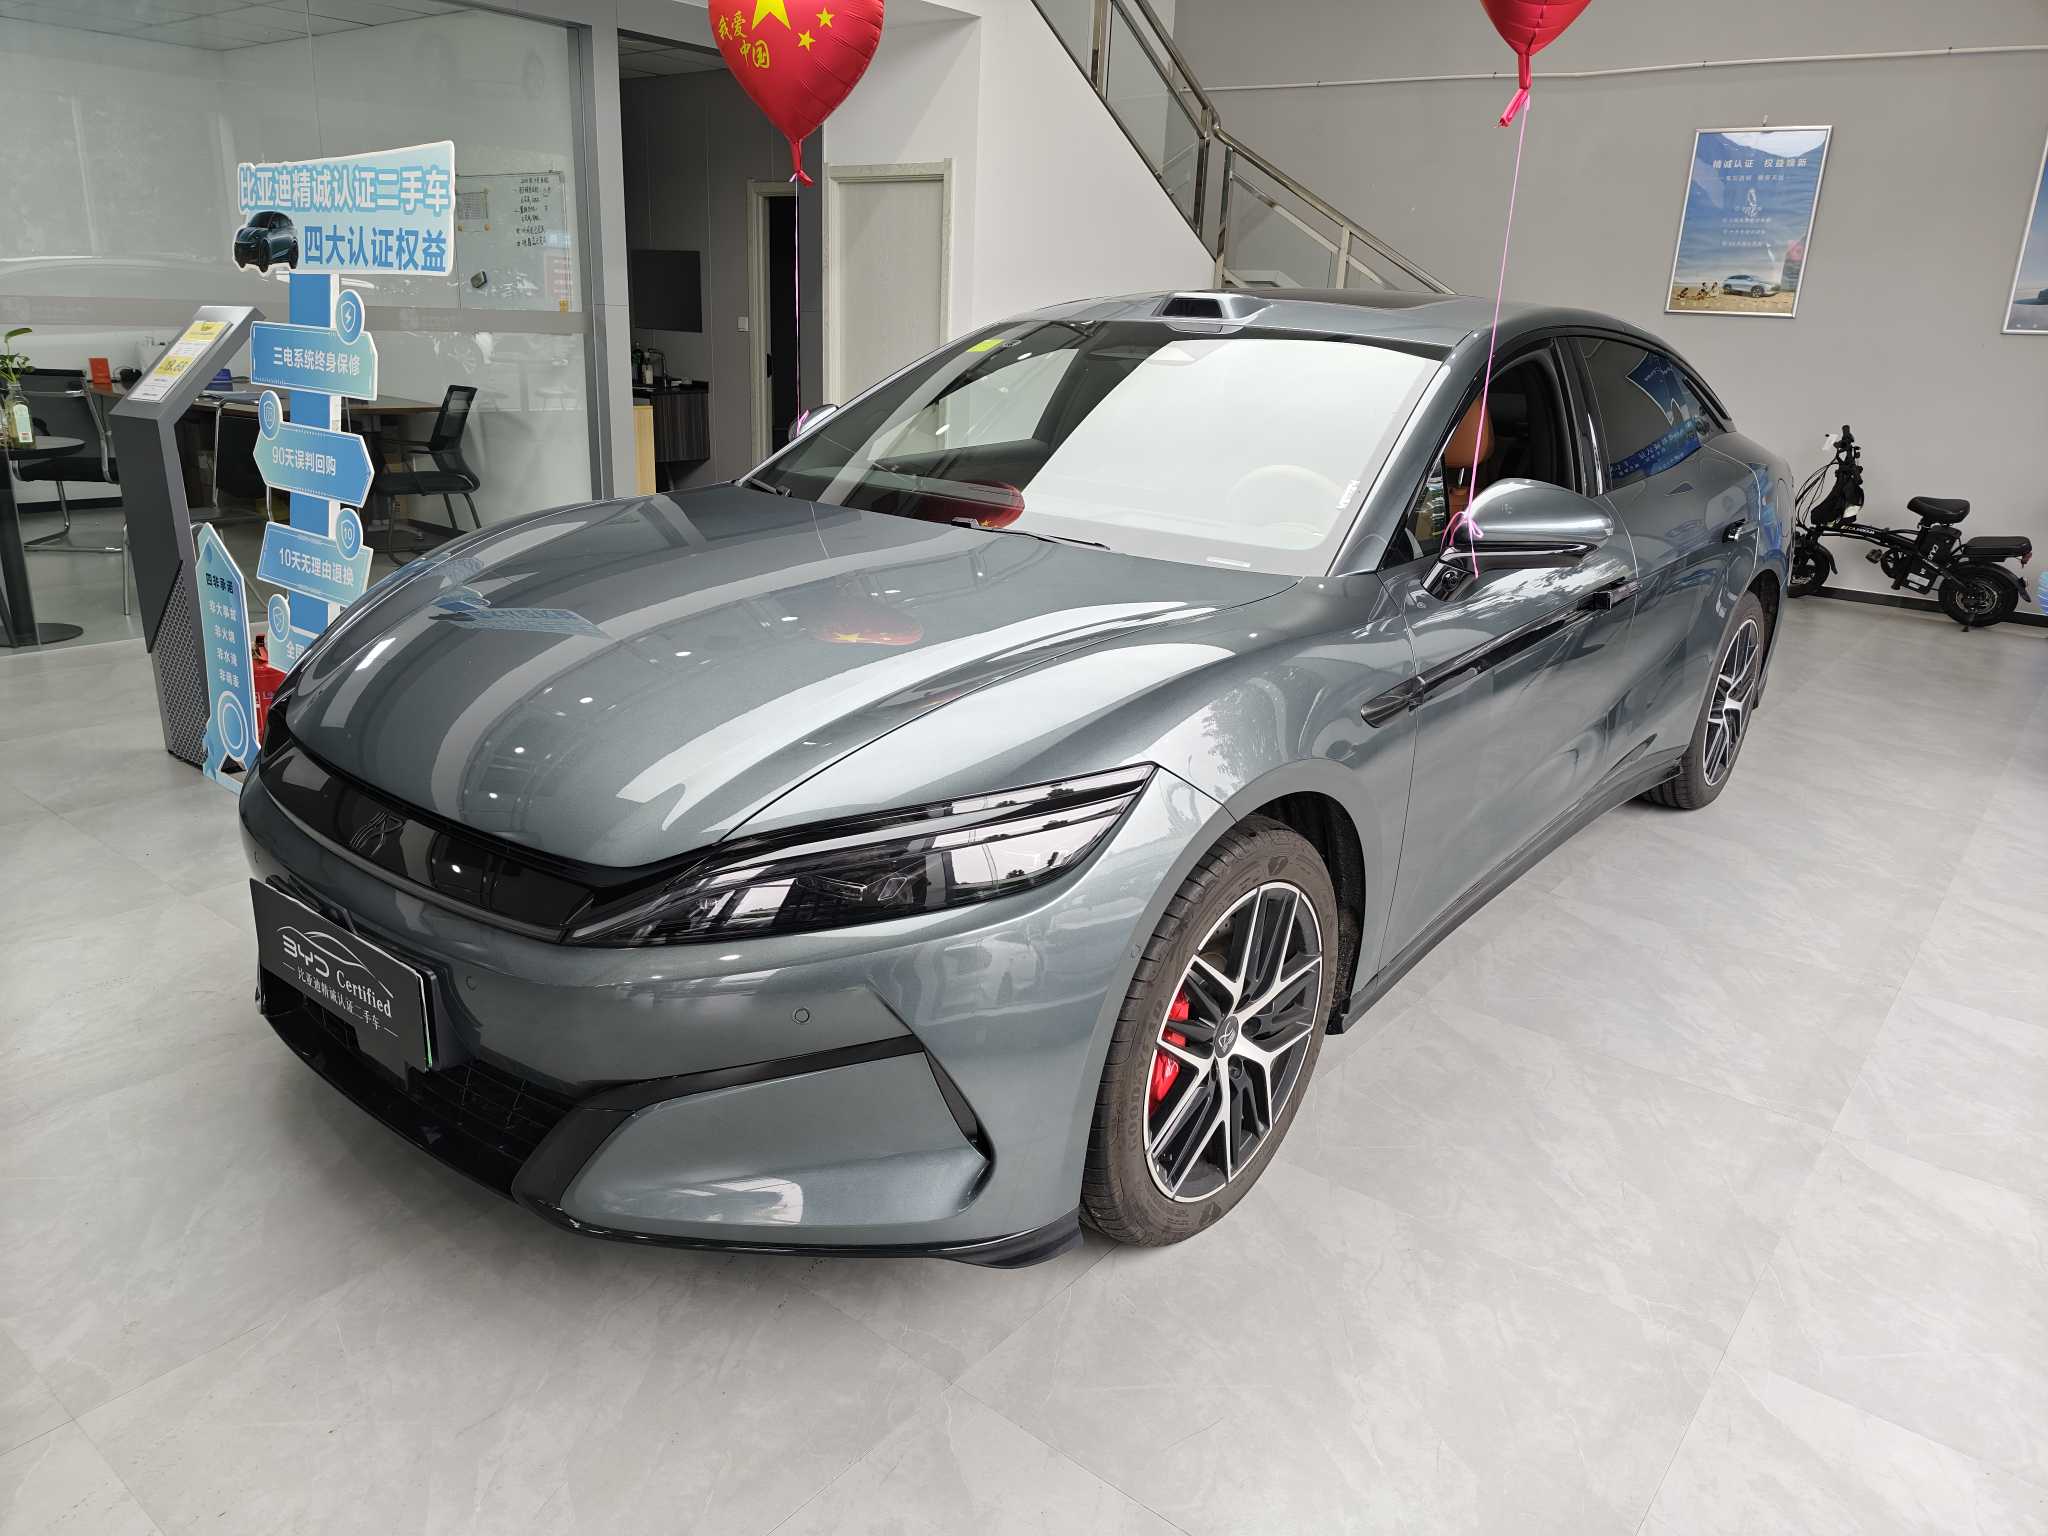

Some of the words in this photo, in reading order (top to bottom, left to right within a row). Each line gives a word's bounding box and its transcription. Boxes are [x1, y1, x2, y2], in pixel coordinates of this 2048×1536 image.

[718, 10, 748, 40] 我爱
[739, 39, 770, 68] 中国
[239, 167, 450, 214] 比亚迪精诚认证二手车
[303, 224, 446, 272] 四大认证权益
[272, 345, 360, 376] 三电系统终身保修
[271, 445, 337, 476] 90天误判回购
[343, 527, 352, 539] 10
[279, 546, 354, 586] 10天无理由退换
[282, 934, 330, 978] BYD
[336, 969, 393, 1018] Certified
